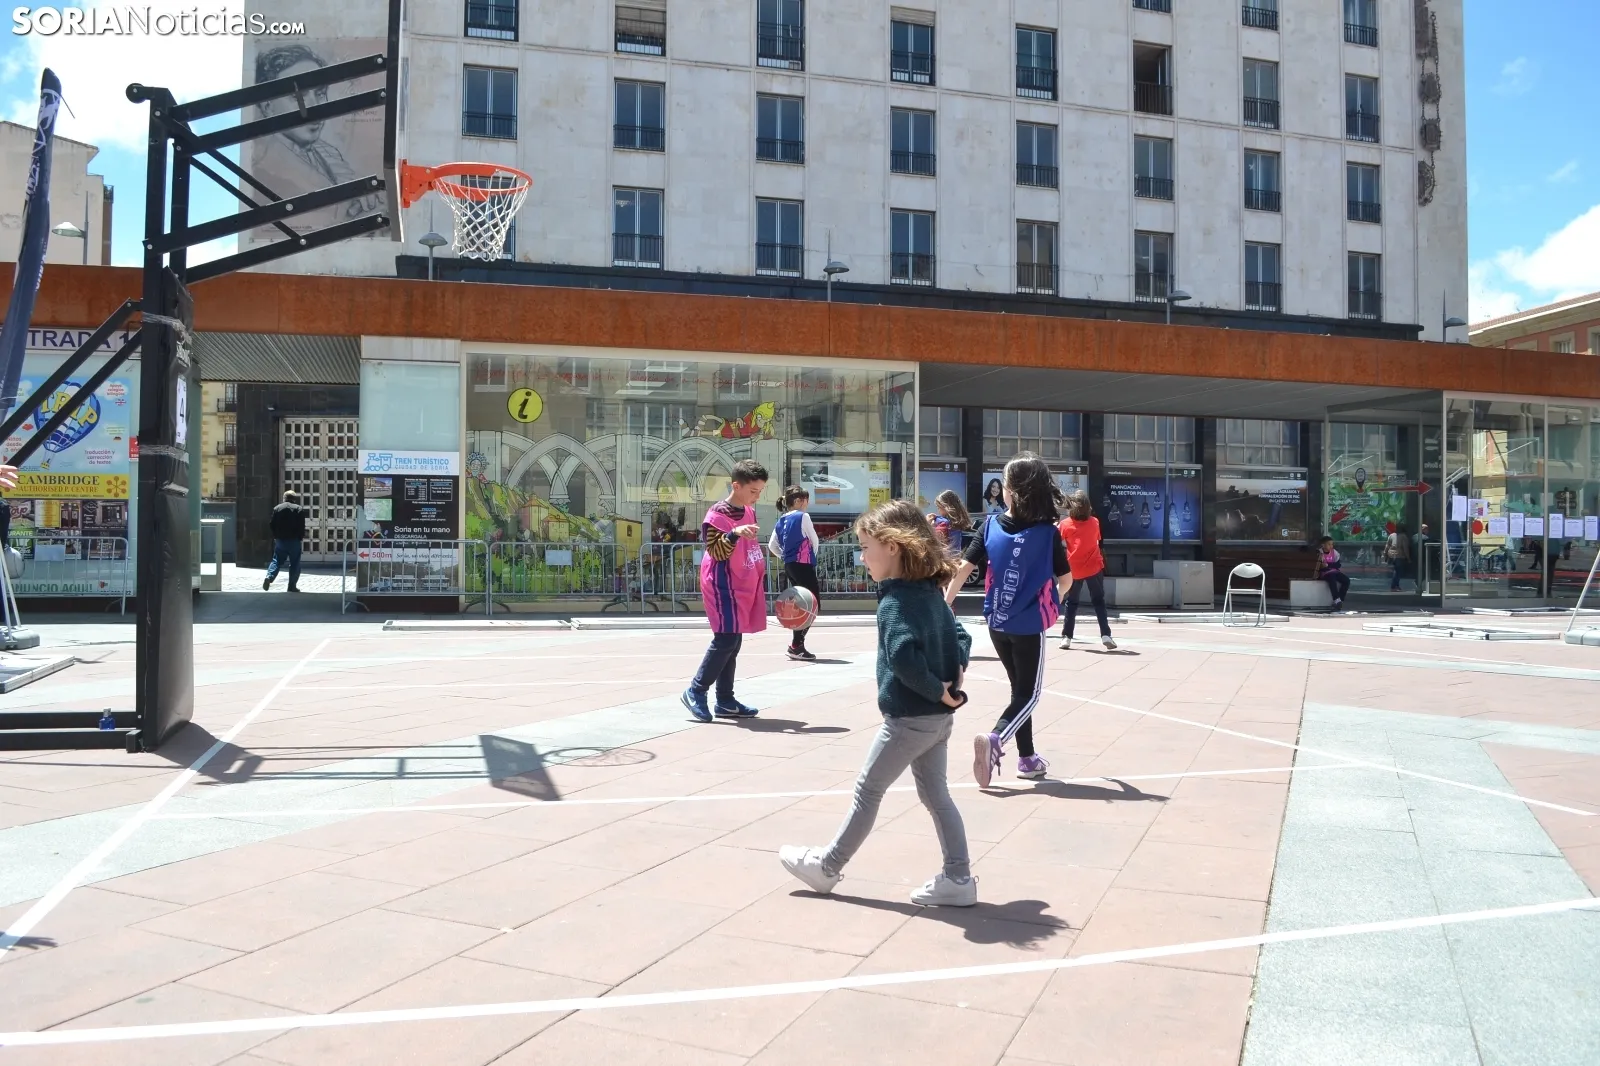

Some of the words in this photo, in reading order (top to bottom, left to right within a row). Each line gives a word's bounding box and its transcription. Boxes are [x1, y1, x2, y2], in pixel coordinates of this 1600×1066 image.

[28, 329, 111, 349] TRADA
[414, 456, 449, 465] TURÍSTICO
[17, 475, 100, 485] CAMBRIDGE
[372, 551, 392, 559] 500m
